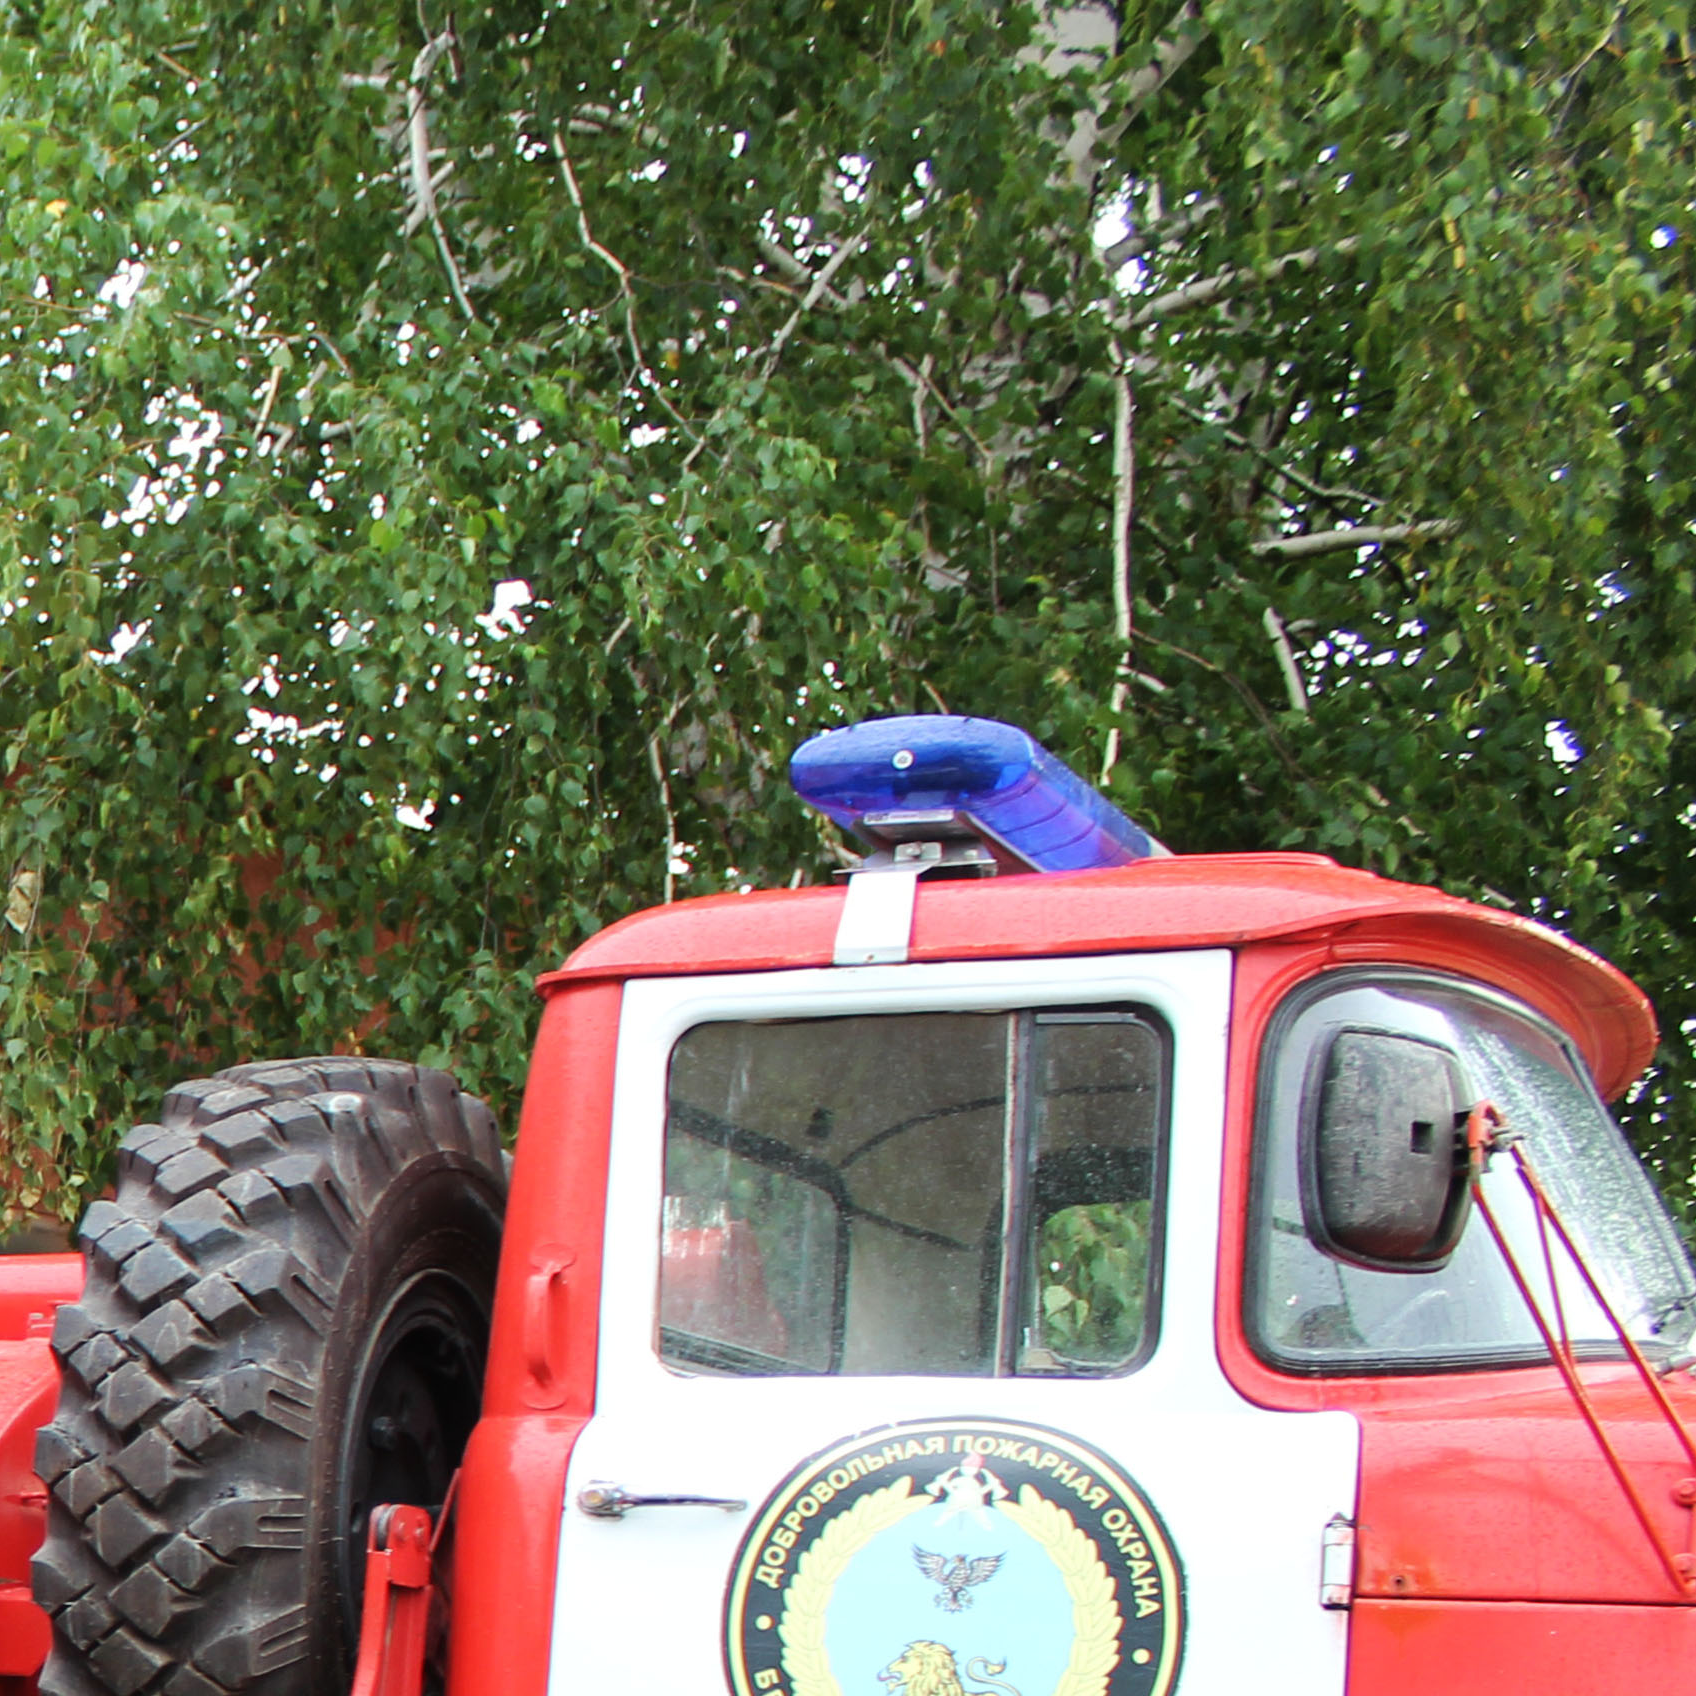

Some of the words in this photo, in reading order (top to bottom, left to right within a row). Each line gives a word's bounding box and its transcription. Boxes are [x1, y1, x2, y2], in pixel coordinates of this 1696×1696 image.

[755, 1435, 945, 1588] ДОБРОВОЛЬНАЯ
[952, 1435, 1109, 1510] ПОЖАРНАЯ
[1101, 1507, 1162, 1619] ОХРАНА
